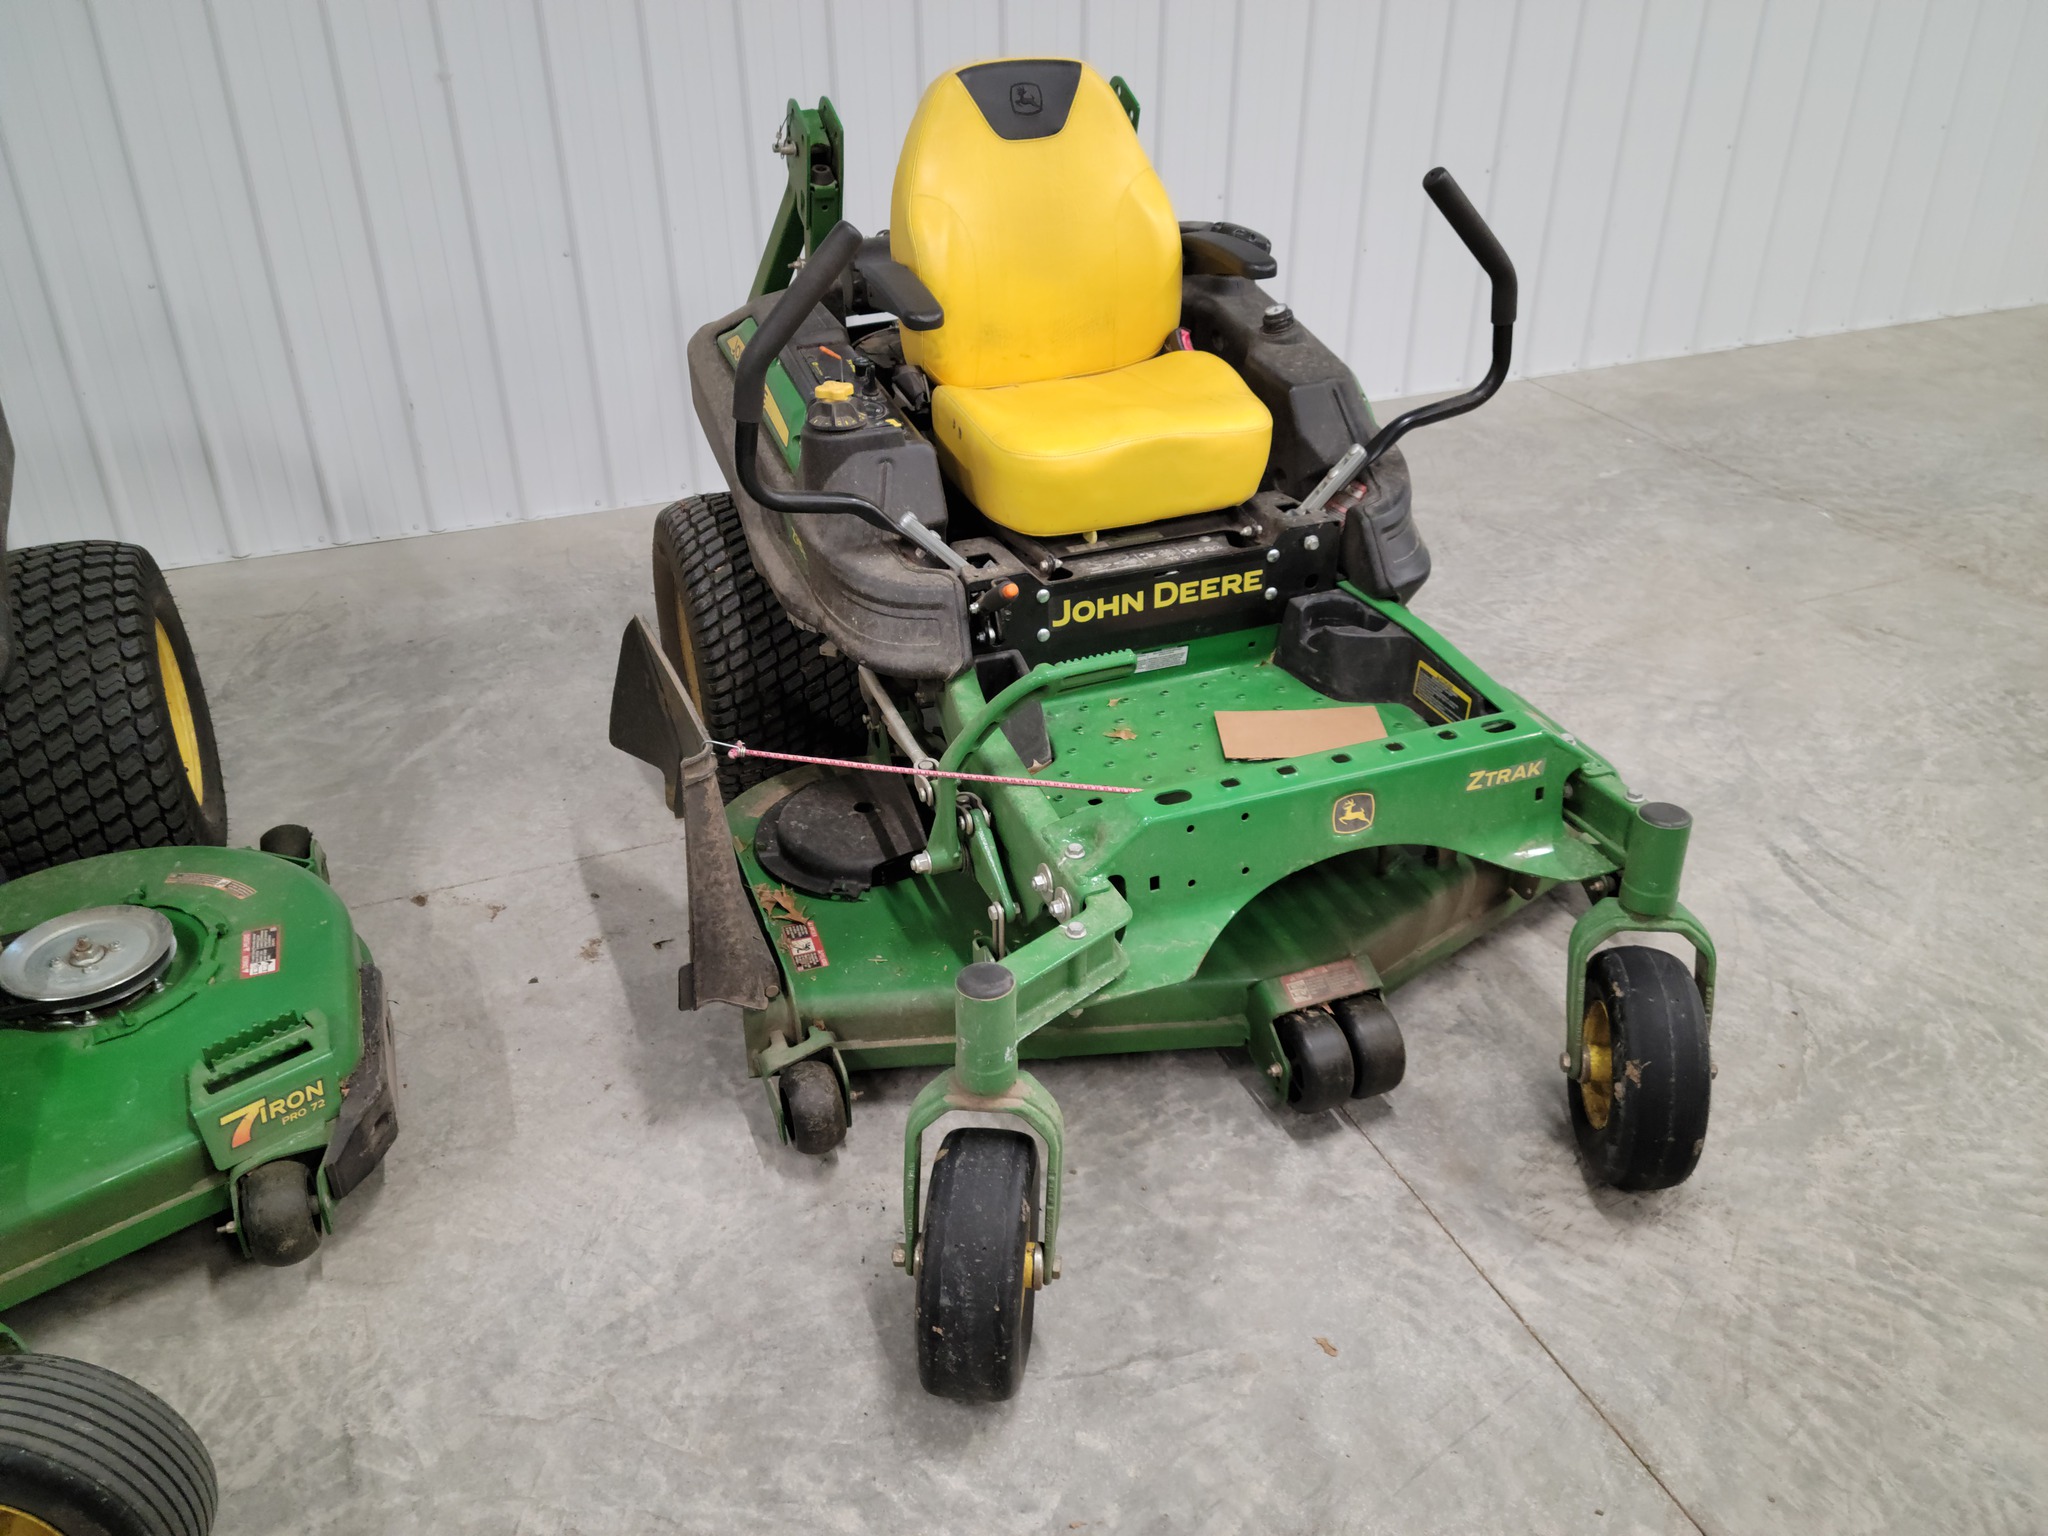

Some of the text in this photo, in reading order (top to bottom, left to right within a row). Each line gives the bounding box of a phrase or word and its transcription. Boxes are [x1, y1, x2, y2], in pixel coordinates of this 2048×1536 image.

[1052, 569, 1264, 628] JOHN DEERE
[1466, 760, 1543, 792] ZTRAK
[281, 1098, 326, 1126] PRO 72
